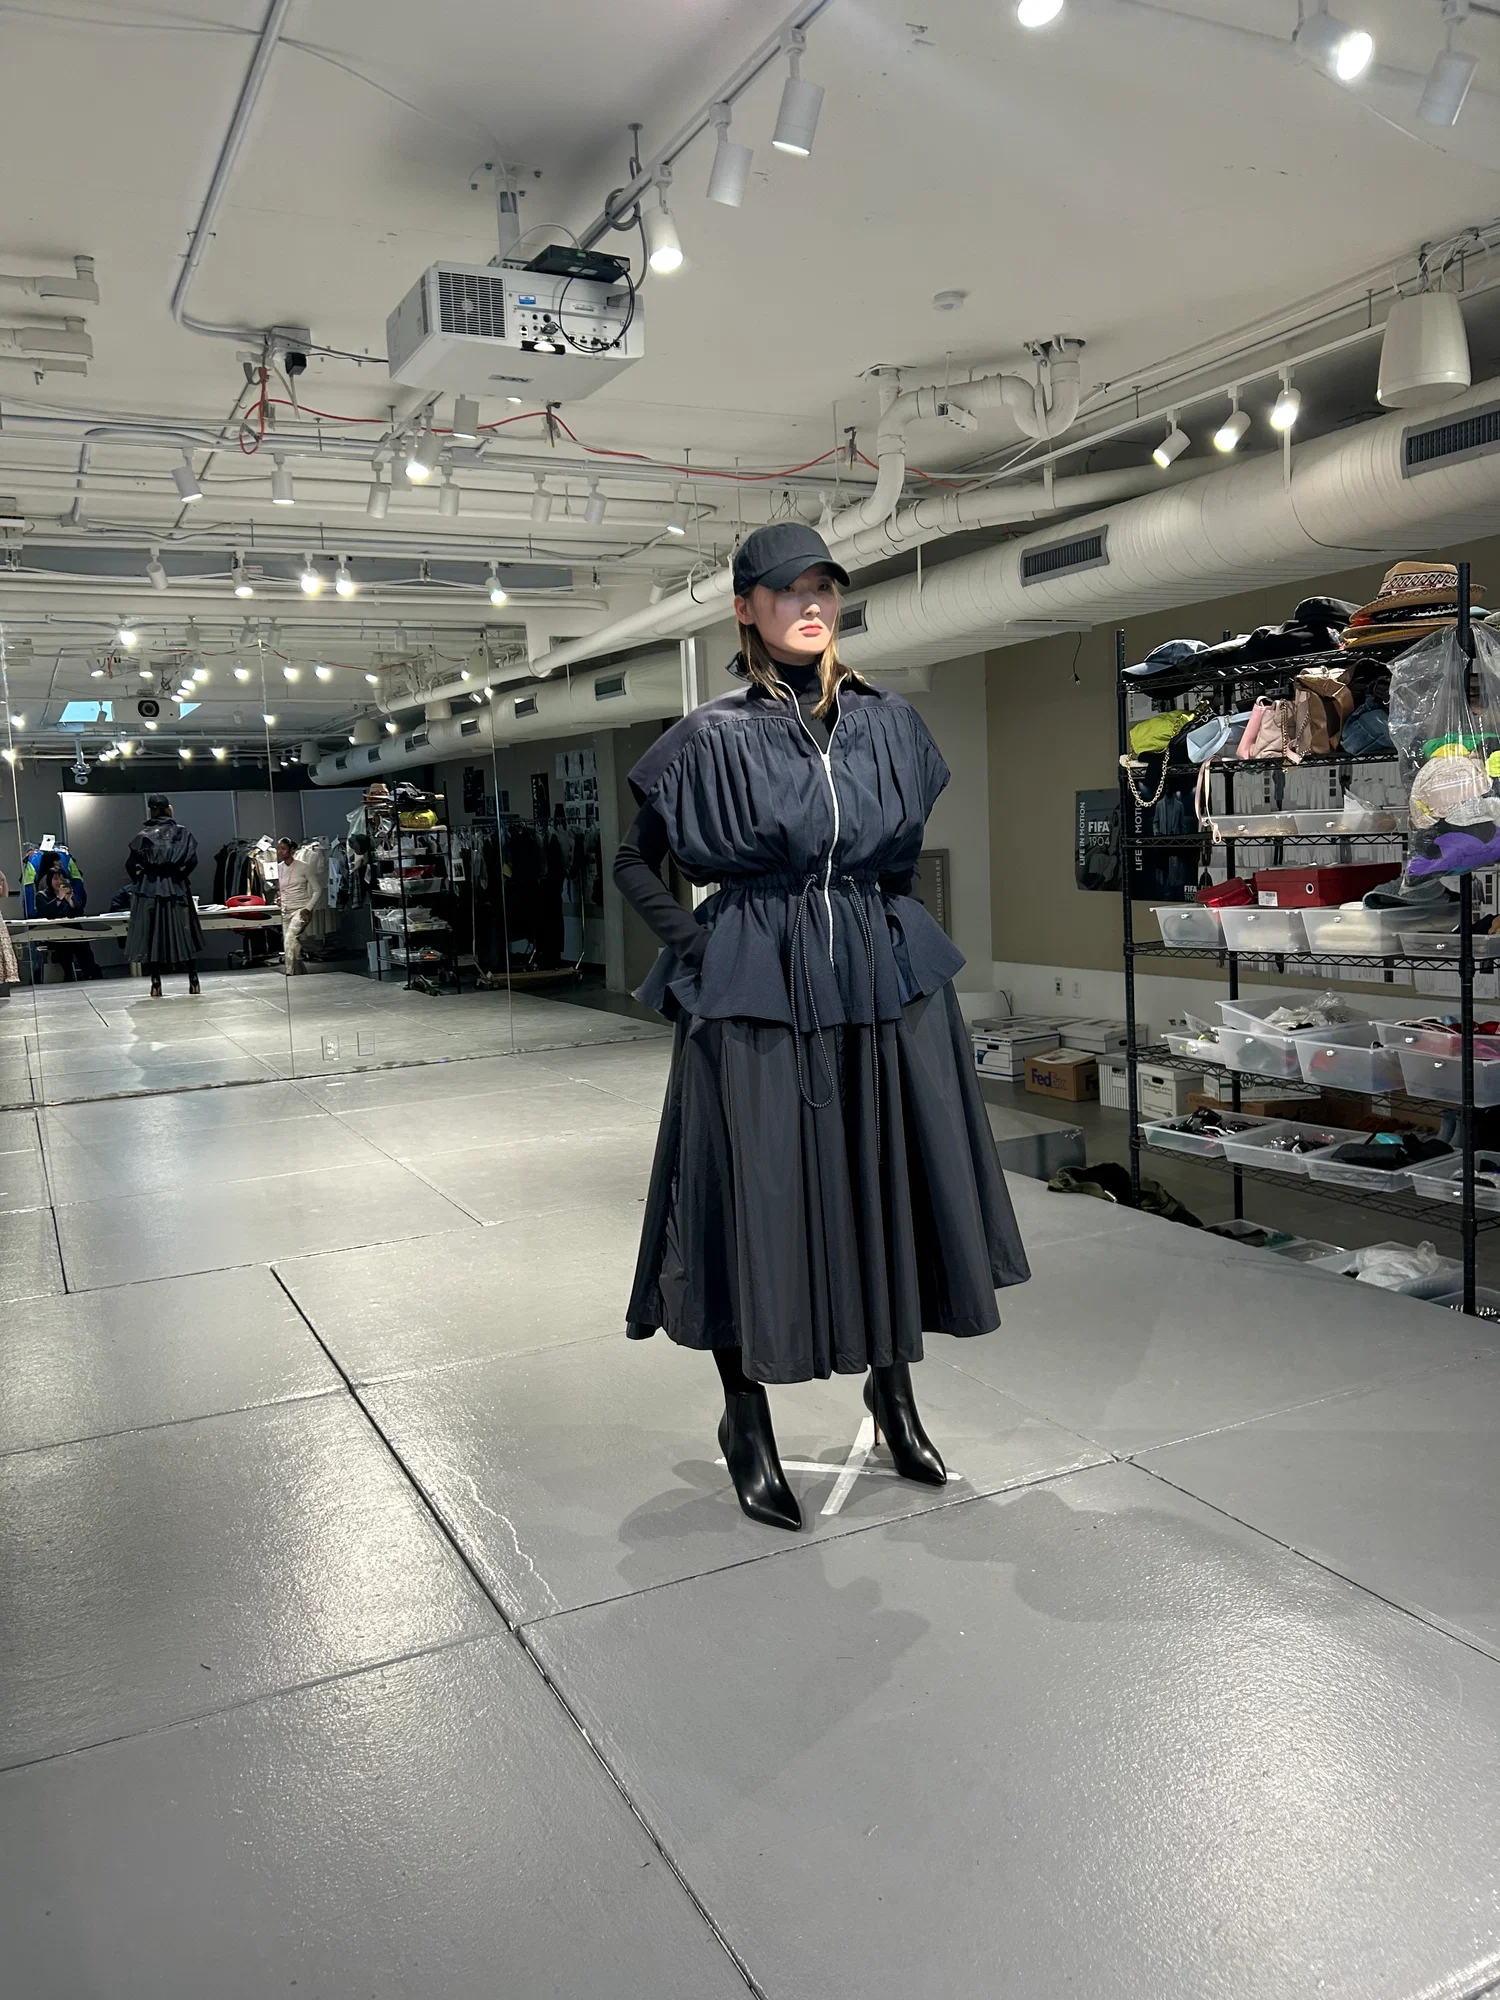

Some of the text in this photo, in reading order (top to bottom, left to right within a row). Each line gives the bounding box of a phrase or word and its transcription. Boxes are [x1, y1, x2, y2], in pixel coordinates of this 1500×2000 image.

[1088, 821, 1110, 832] FIFA
[1079, 837, 1085, 847] IN
[1088, 836, 1110, 846] 1904
[1135, 849, 1143, 871] LIFE
[1184, 885, 1197, 893] FIFA
[1031, 1068, 1067, 1090] FedEx
